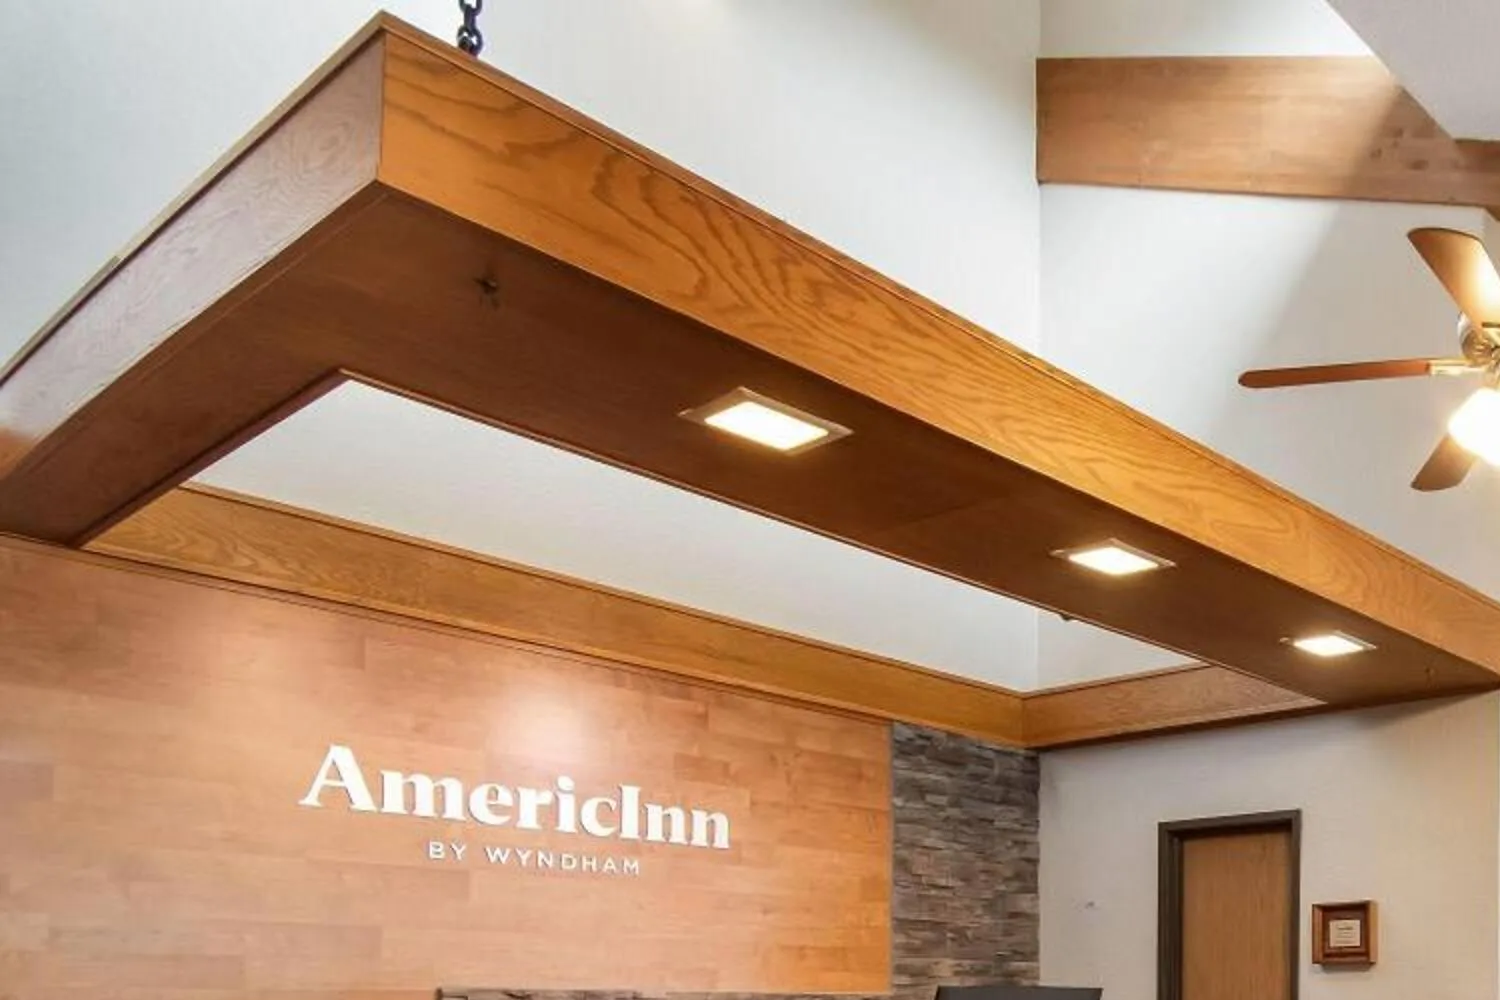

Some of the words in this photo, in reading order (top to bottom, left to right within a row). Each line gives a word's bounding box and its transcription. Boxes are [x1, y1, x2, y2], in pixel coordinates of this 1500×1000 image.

[299, 744, 731, 850] AmericInn
[428, 840, 467, 861] BY
[485, 846, 641, 876] WYNDHAM
